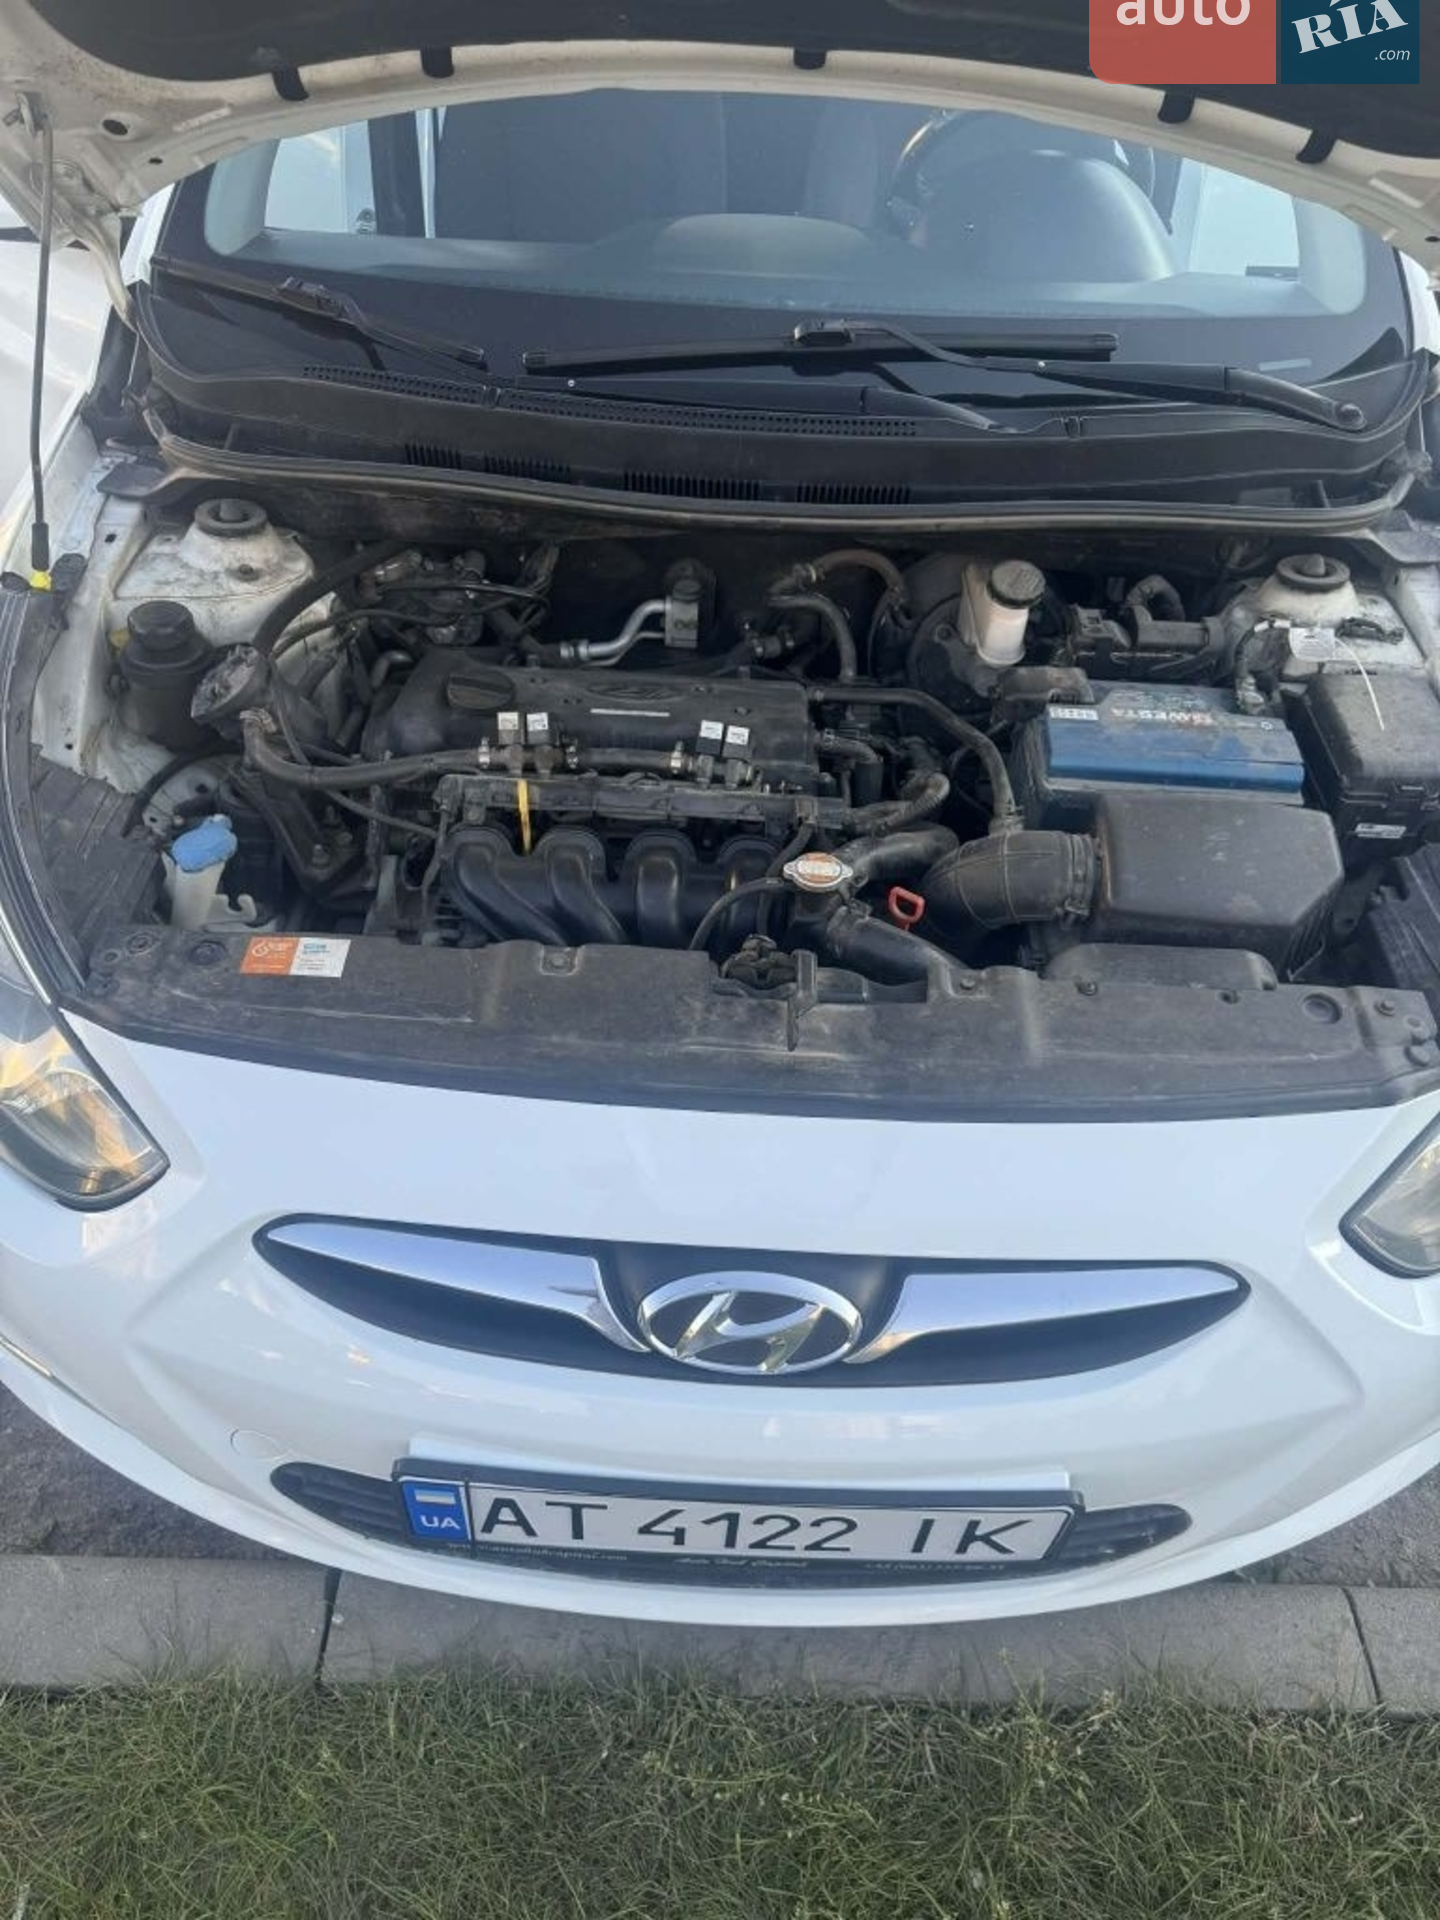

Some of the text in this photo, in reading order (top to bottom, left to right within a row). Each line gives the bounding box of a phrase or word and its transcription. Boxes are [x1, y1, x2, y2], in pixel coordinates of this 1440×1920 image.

[420, 1514, 461, 1530] UA
[480, 1497, 1033, 1555] AT 4122 IK
